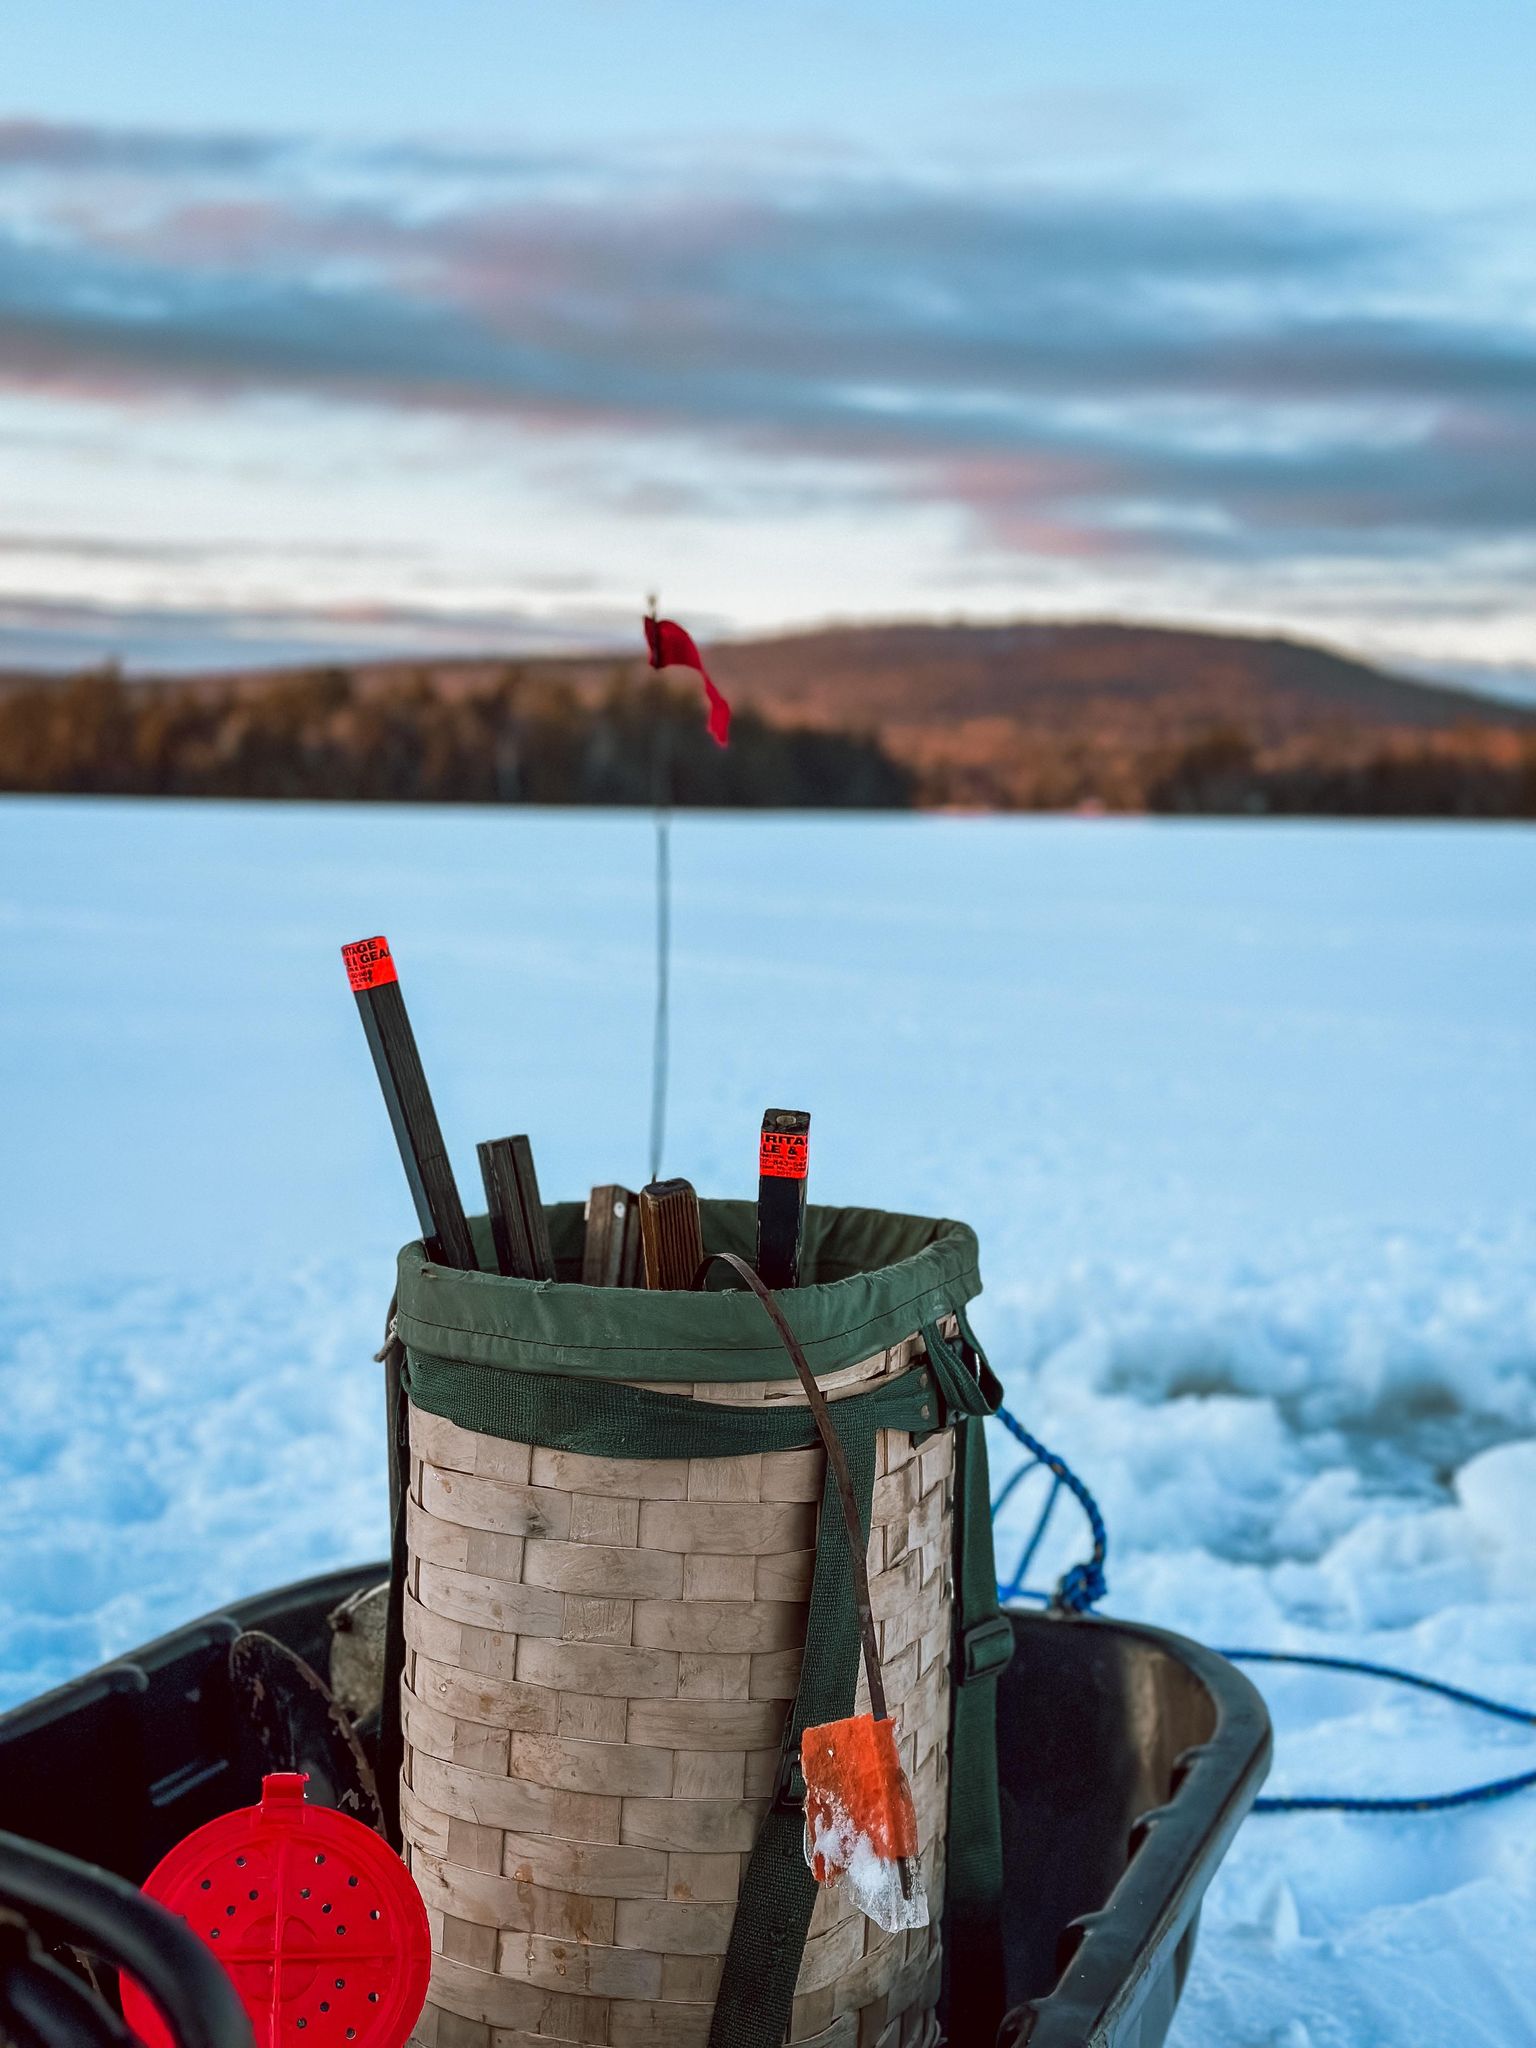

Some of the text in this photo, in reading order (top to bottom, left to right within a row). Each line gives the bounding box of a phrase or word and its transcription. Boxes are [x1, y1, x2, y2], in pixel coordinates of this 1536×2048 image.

[765, 1135, 807, 1146] RITA
[763, 1144, 797, 1155] LE &
